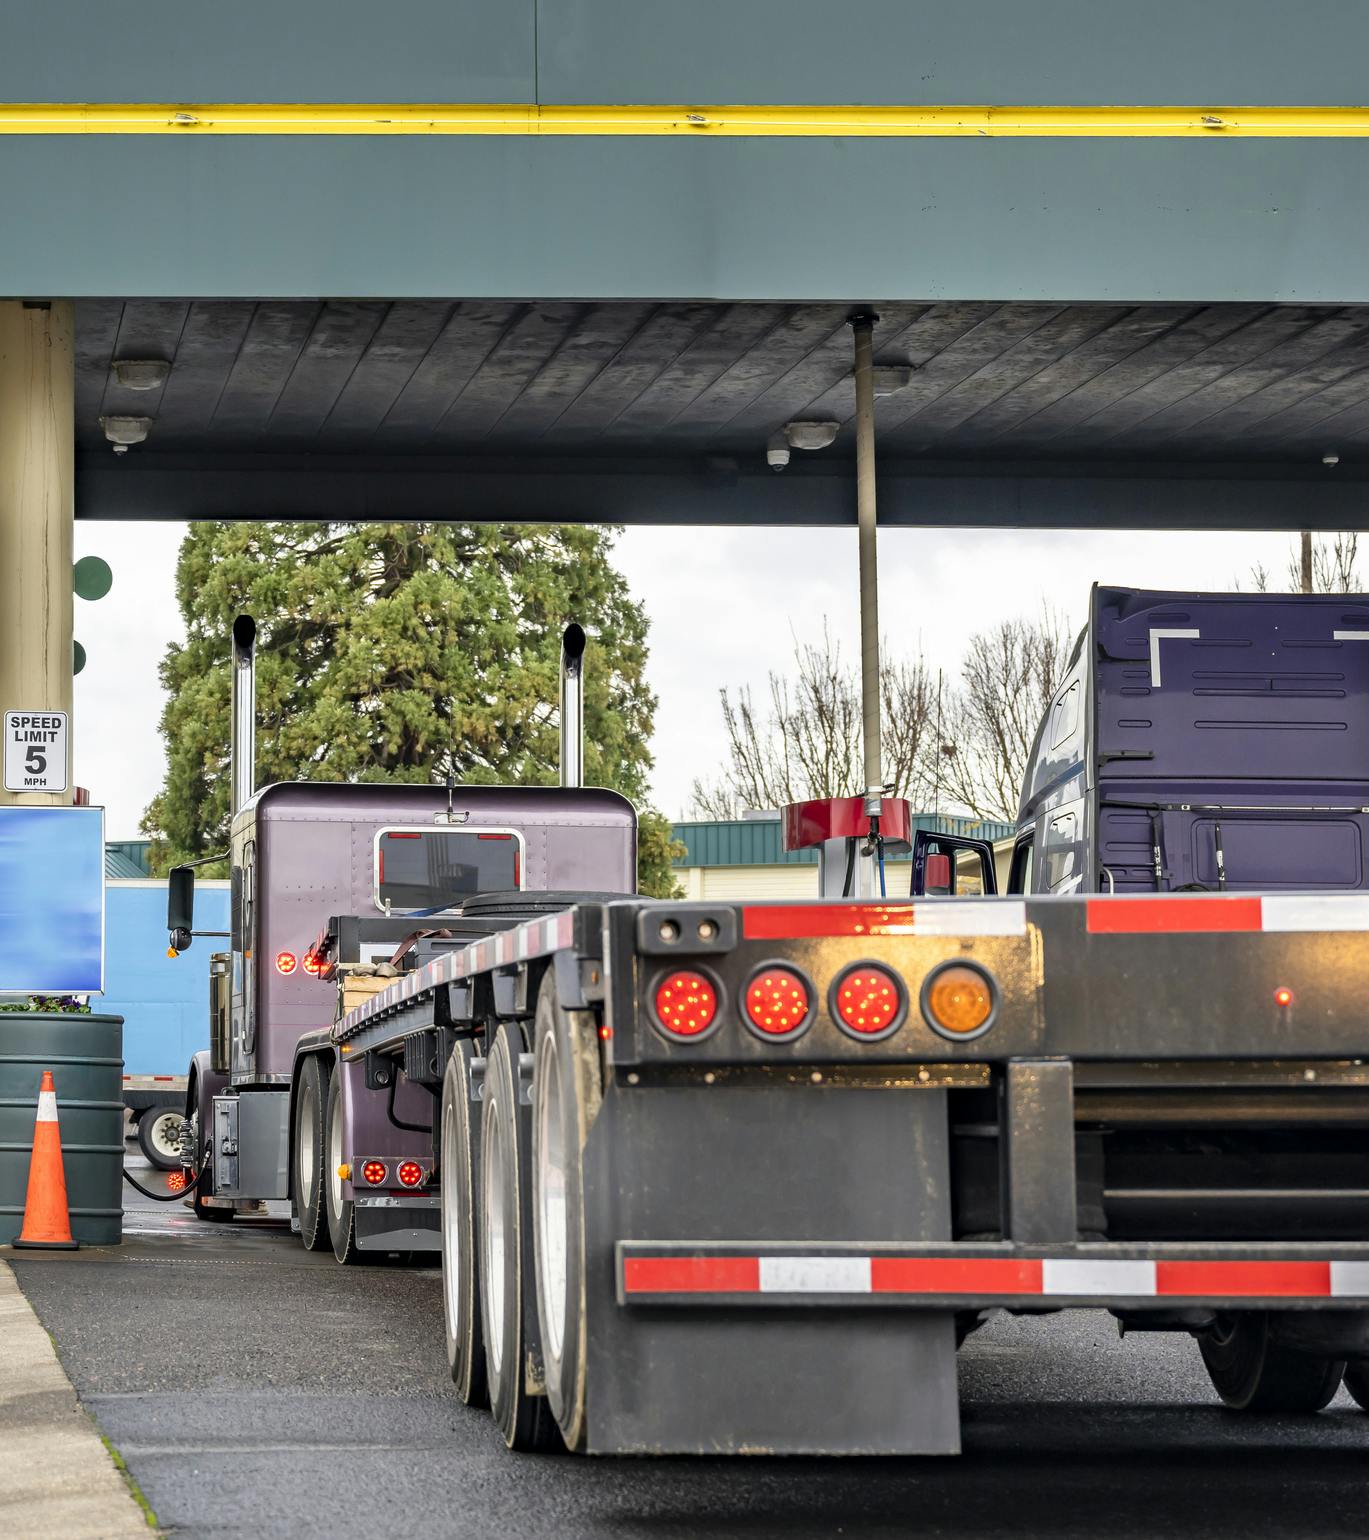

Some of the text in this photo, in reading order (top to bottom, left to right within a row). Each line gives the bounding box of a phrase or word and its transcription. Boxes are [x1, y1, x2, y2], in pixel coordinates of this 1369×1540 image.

[11, 717, 62, 729] SPEED
[14, 731, 58, 742] LIMIT
[24, 745, 47, 775] 5
[24, 778, 47, 786] MPH
